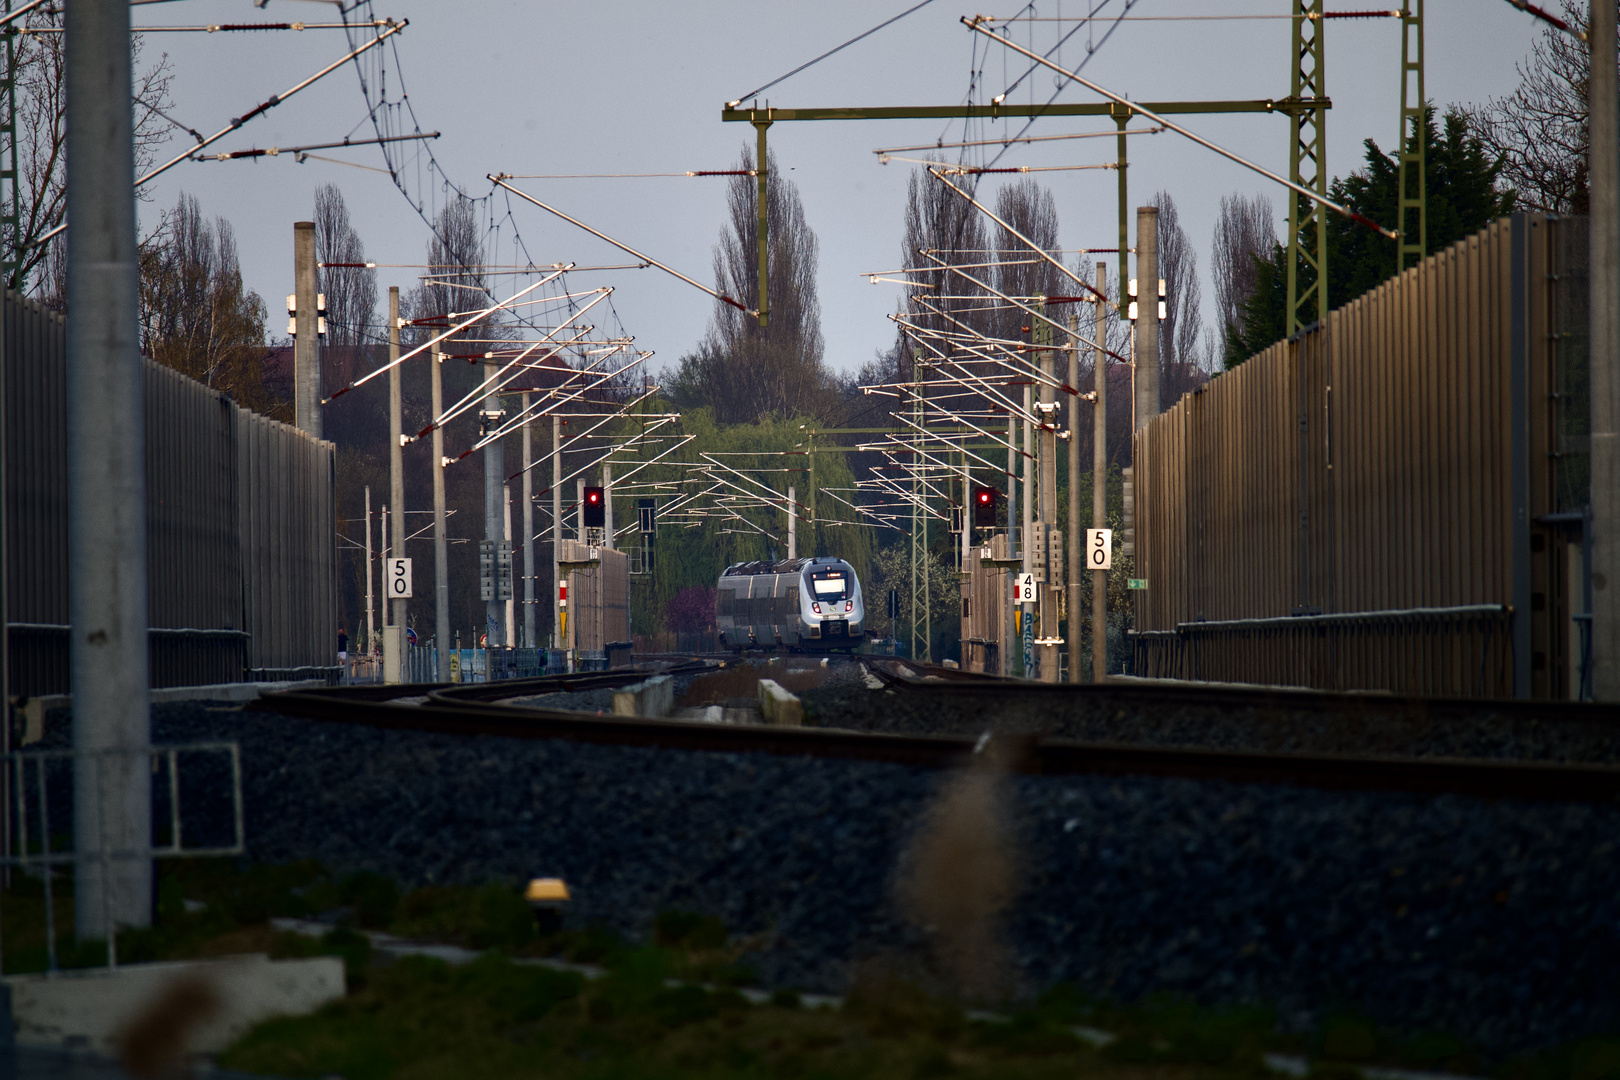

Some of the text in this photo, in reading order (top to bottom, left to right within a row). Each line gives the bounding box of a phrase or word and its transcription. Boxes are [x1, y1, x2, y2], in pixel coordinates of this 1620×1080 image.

[1094, 531, 1105, 547] 5
[394, 560, 406, 577] 5
[1024, 574, 1032, 586] 4
[1024, 587, 1032, 599] 8
